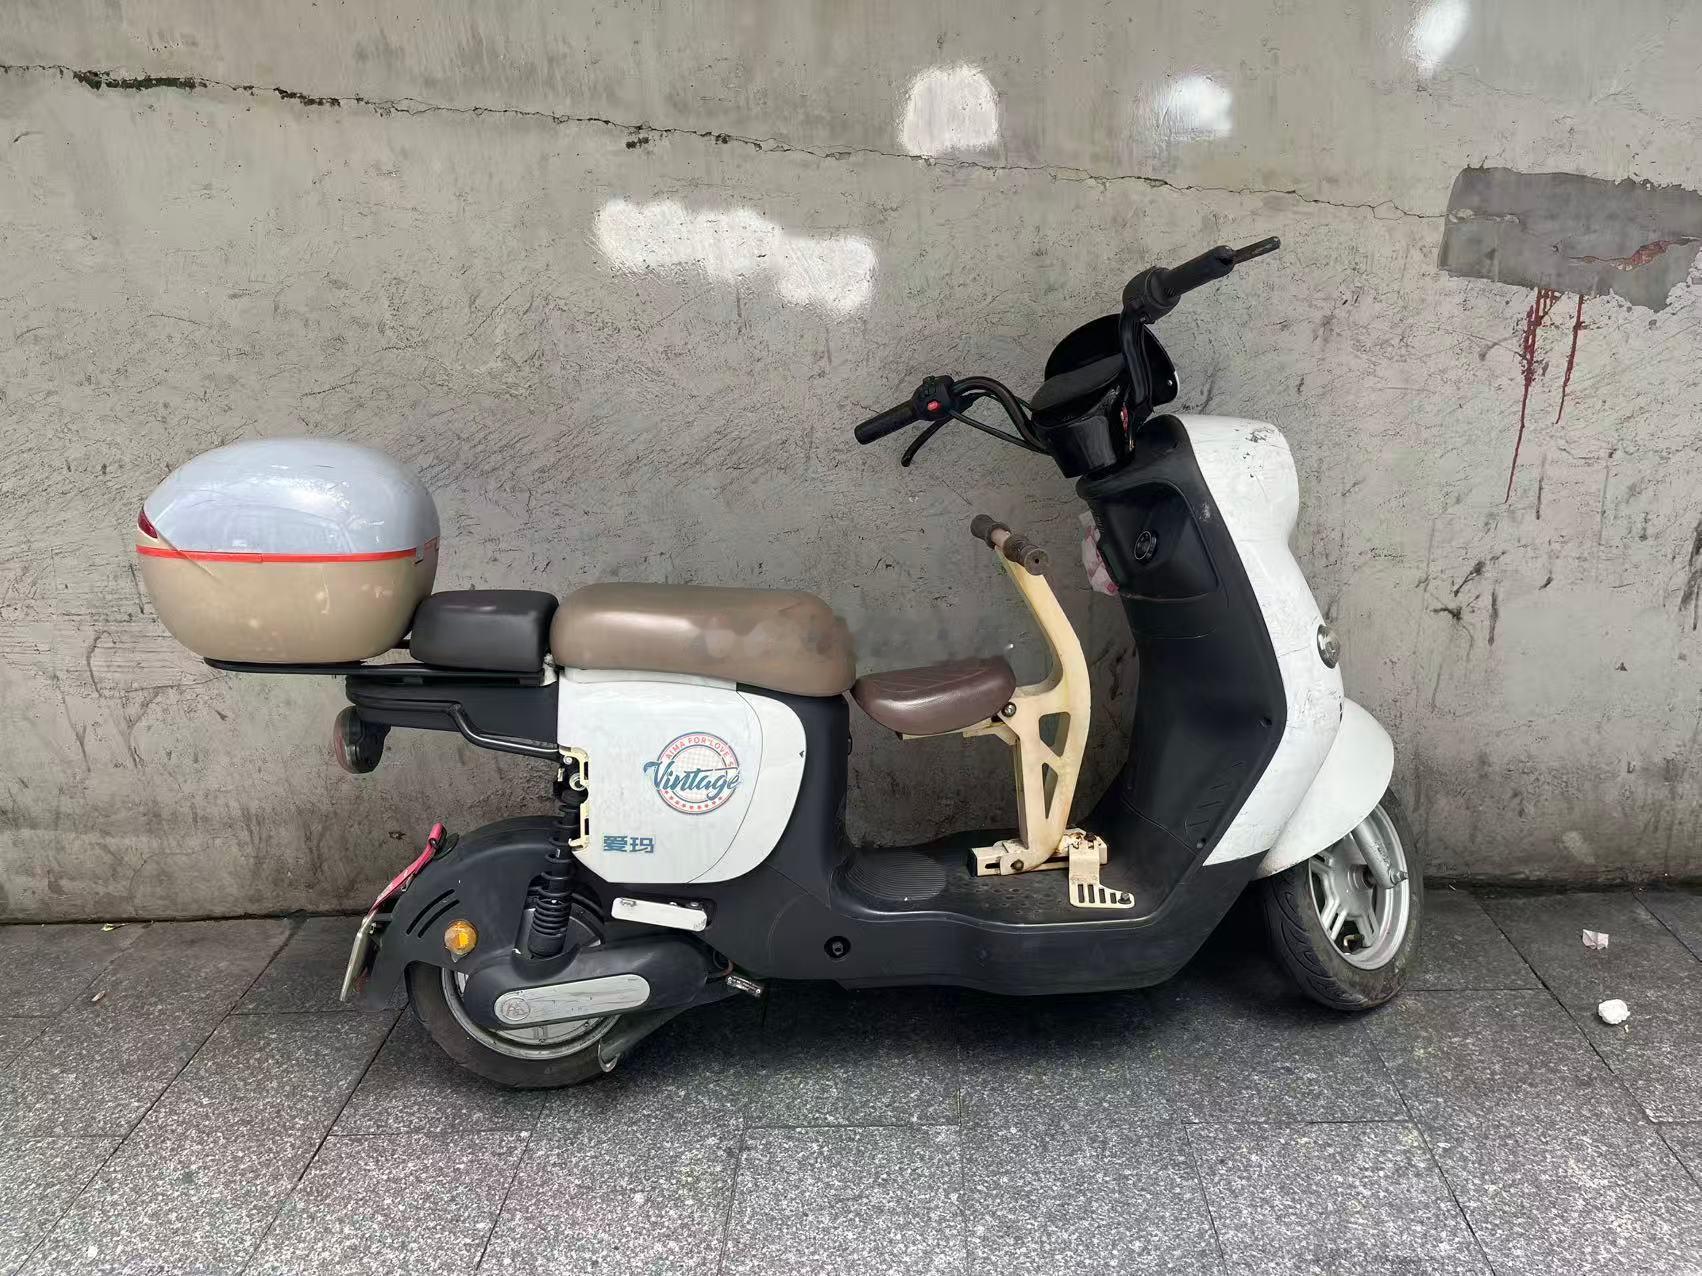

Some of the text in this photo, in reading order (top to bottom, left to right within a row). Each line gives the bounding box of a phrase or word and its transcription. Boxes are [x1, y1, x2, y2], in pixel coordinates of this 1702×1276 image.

[665, 741, 686, 760] AIMA
[688, 736, 707, 744] FOR
[643, 760, 740, 801] Vintage
[603, 835, 654, 853] 爱玛
